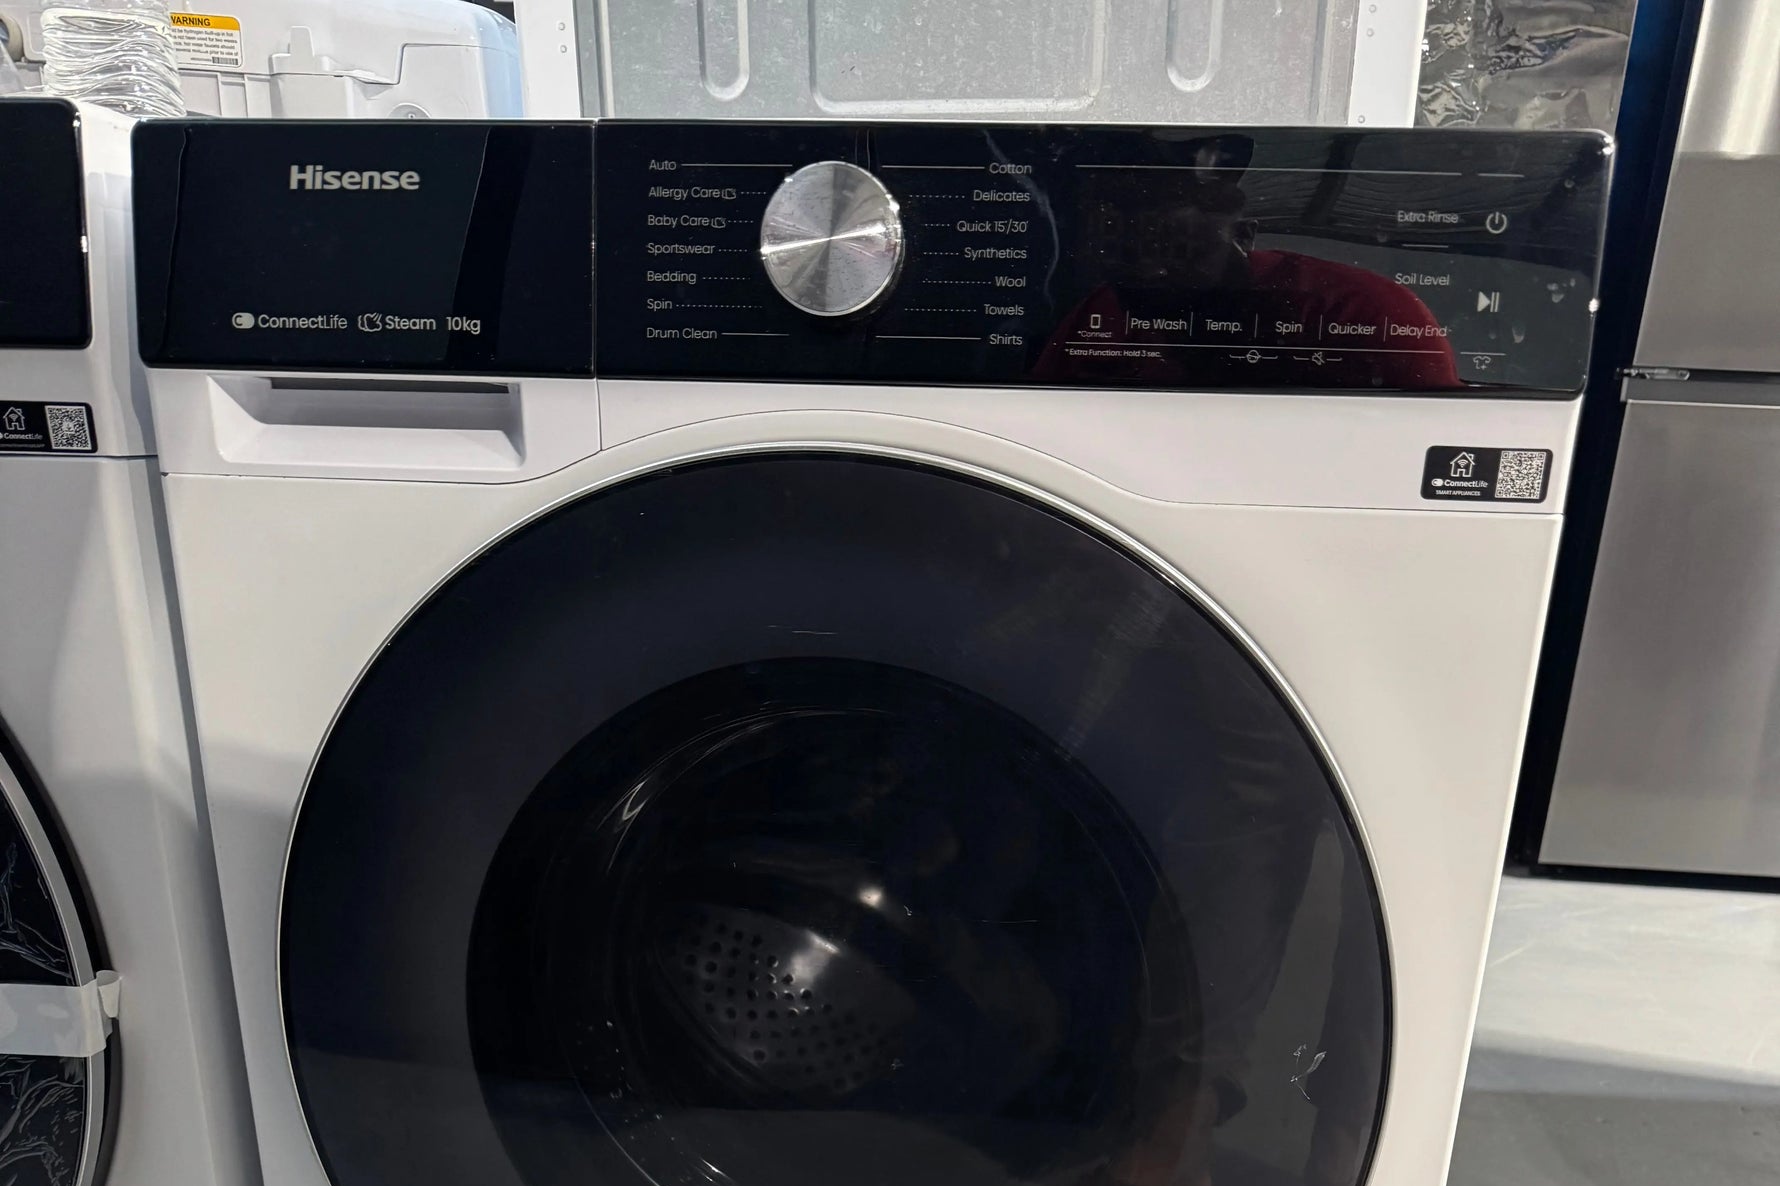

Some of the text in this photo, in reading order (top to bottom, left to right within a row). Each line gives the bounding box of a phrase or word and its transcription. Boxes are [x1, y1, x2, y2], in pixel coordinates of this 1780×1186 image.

[649, 160, 677, 171] Auto
[989, 162, 1033, 174] Cotton
[289, 164, 421, 190] Hisense
[648, 187, 721, 200] Allergy Care
[973, 190, 1031, 202] Delicates
[647, 215, 710, 228] Baby Care
[1397, 210, 1459, 224] Extra Rinse
[956, 220, 991, 233] Quick
[647, 242, 716, 256] Sportswear
[964, 246, 1028, 261] Synthetics
[647, 271, 697, 285] Bedding
[995, 276, 1027, 288] Wool
[1395, 273, 1450, 286] Soil Level
[647, 299, 673, 312] Spin
[984, 304, 1025, 316] Towels
[258, 314, 482, 335] ConnectLife Steam 10kg
[1131, 318, 1187, 330] Pre Wash
[1206, 319, 1243, 334] Temp.
[1275, 321, 1303, 334] Spin
[1328, 322, 1377, 336] Quicker
[646, 328, 718, 340] Drum Clean
[1390, 323, 1448, 340] Delay End
[989, 333, 1023, 346] Shirts
[1089, 348, 1122, 357] Function:
[1444, 479, 1488, 488] ConnectLife
